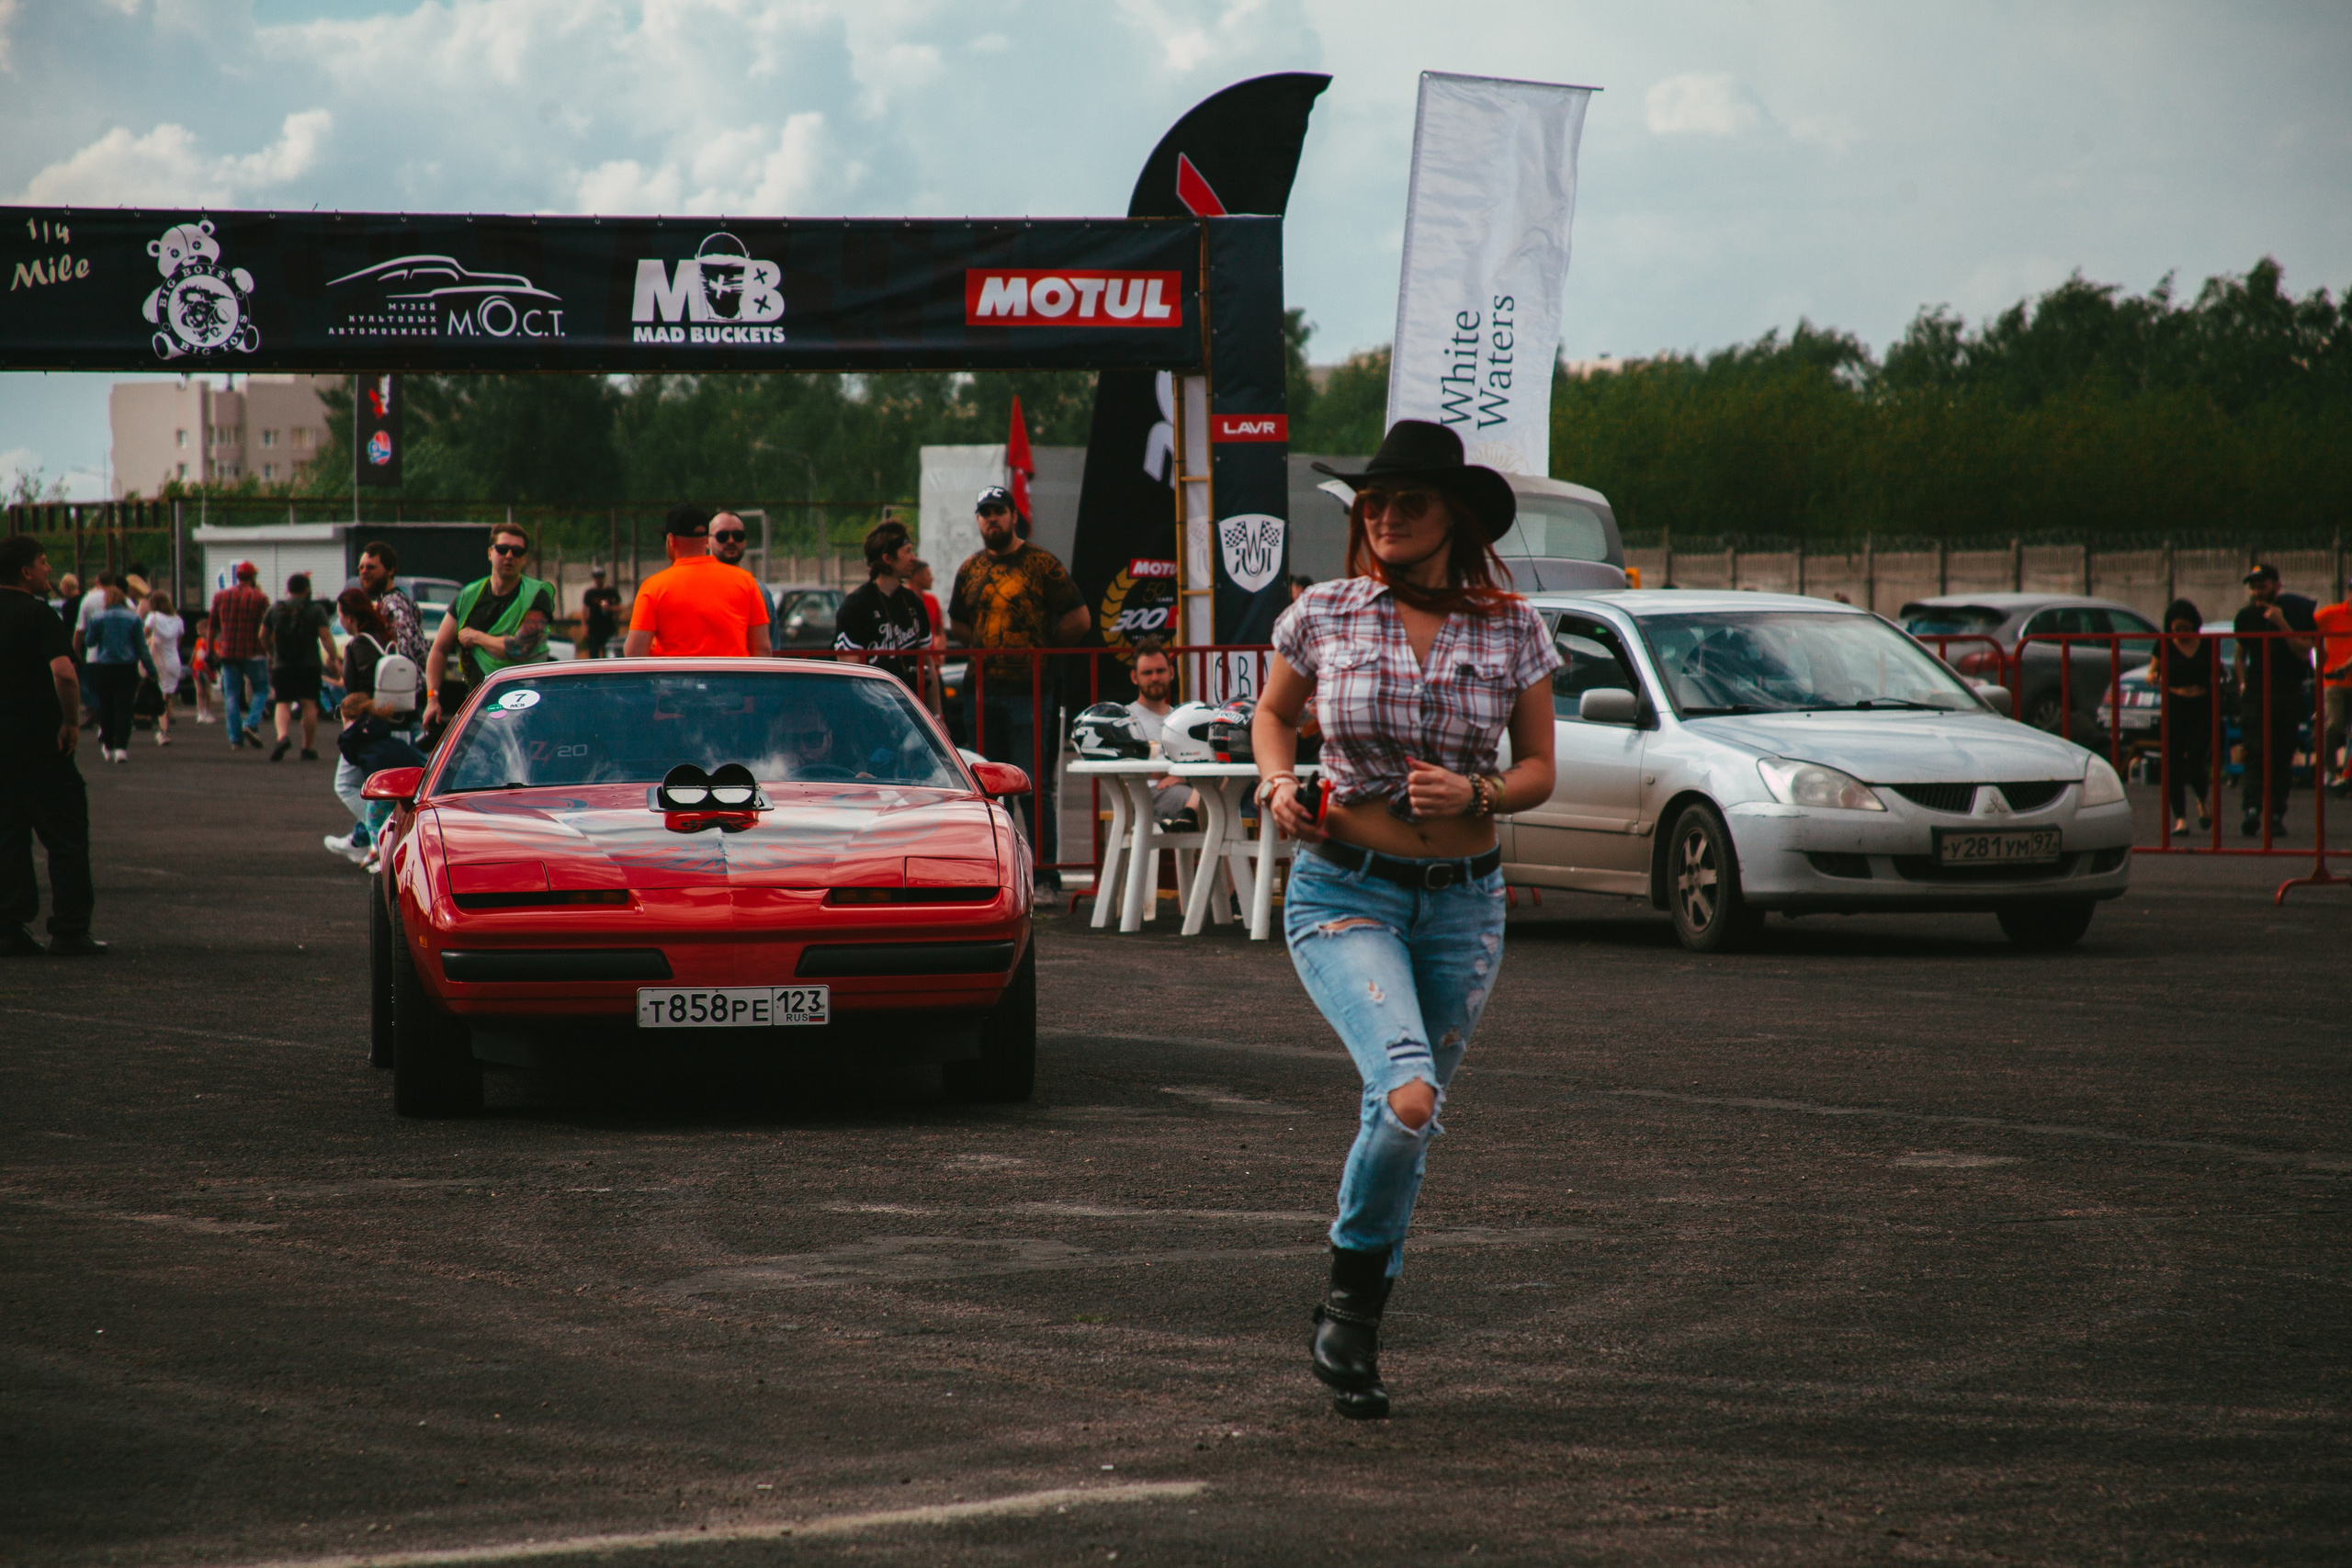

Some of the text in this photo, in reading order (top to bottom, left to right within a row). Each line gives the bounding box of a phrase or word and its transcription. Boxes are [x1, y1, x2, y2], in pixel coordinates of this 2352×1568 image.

[10, 254, 90, 291] Mile
[159, 278, 176, 309] BIG
[976, 276, 1171, 318] MOTUL
[389, 302, 436, 310] МУЗЕЙ
[179, 314, 248, 355] BIG TOYS
[328, 327, 438, 335] АВТОМОБИЛЕЙ
[633, 326, 786, 344] MAD BUCKETS
[1440, 310, 1481, 426] White
[1477, 295, 1515, 430] Waters
[1223, 422, 1275, 434] LAVR
[978, 487, 1004, 502] UFC
[1133, 561, 1178, 576] MOTU
[514, 694, 527, 703] 7
[2034, 833, 2054, 850] 97
[776, 990, 821, 1012] 123
[786, 1013, 808, 1021] RUS
